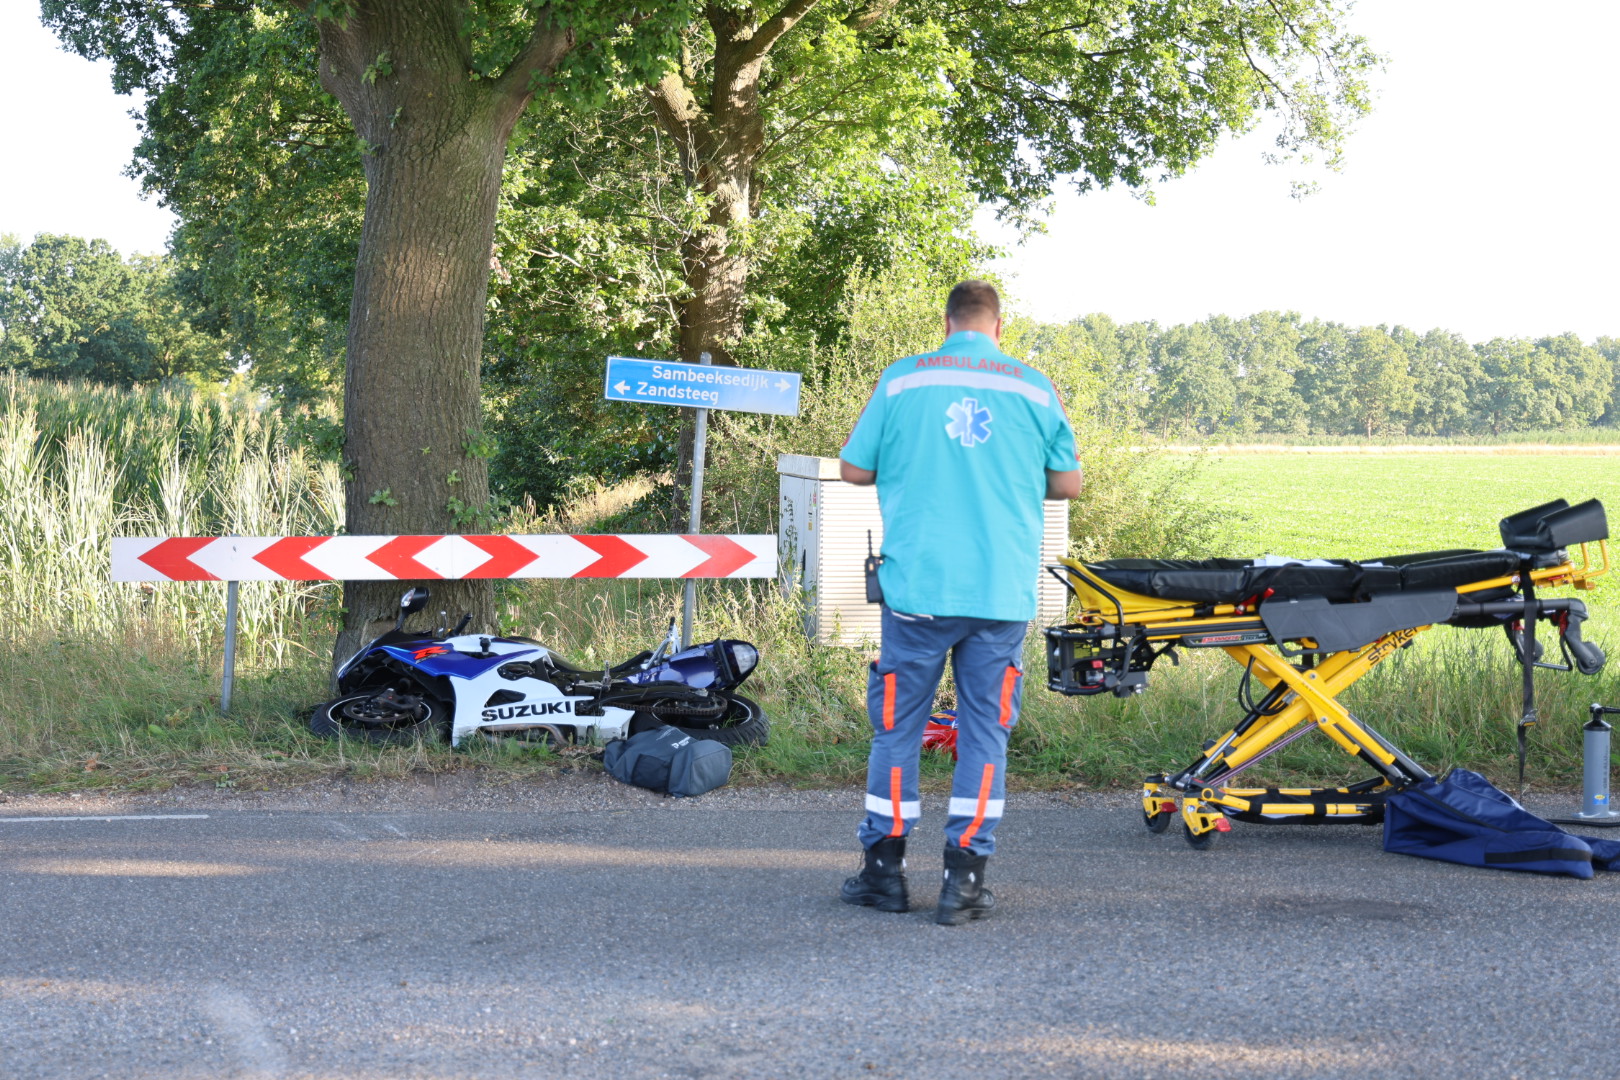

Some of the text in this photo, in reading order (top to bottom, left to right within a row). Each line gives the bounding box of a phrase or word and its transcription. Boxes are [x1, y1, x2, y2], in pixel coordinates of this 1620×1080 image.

[652, 365, 769, 391] Sambeeksedijk
[915, 355, 1024, 378] AMBULANCE
[636, 381, 719, 405] Zandsteeg
[481, 700, 572, 722] SUZUKI
